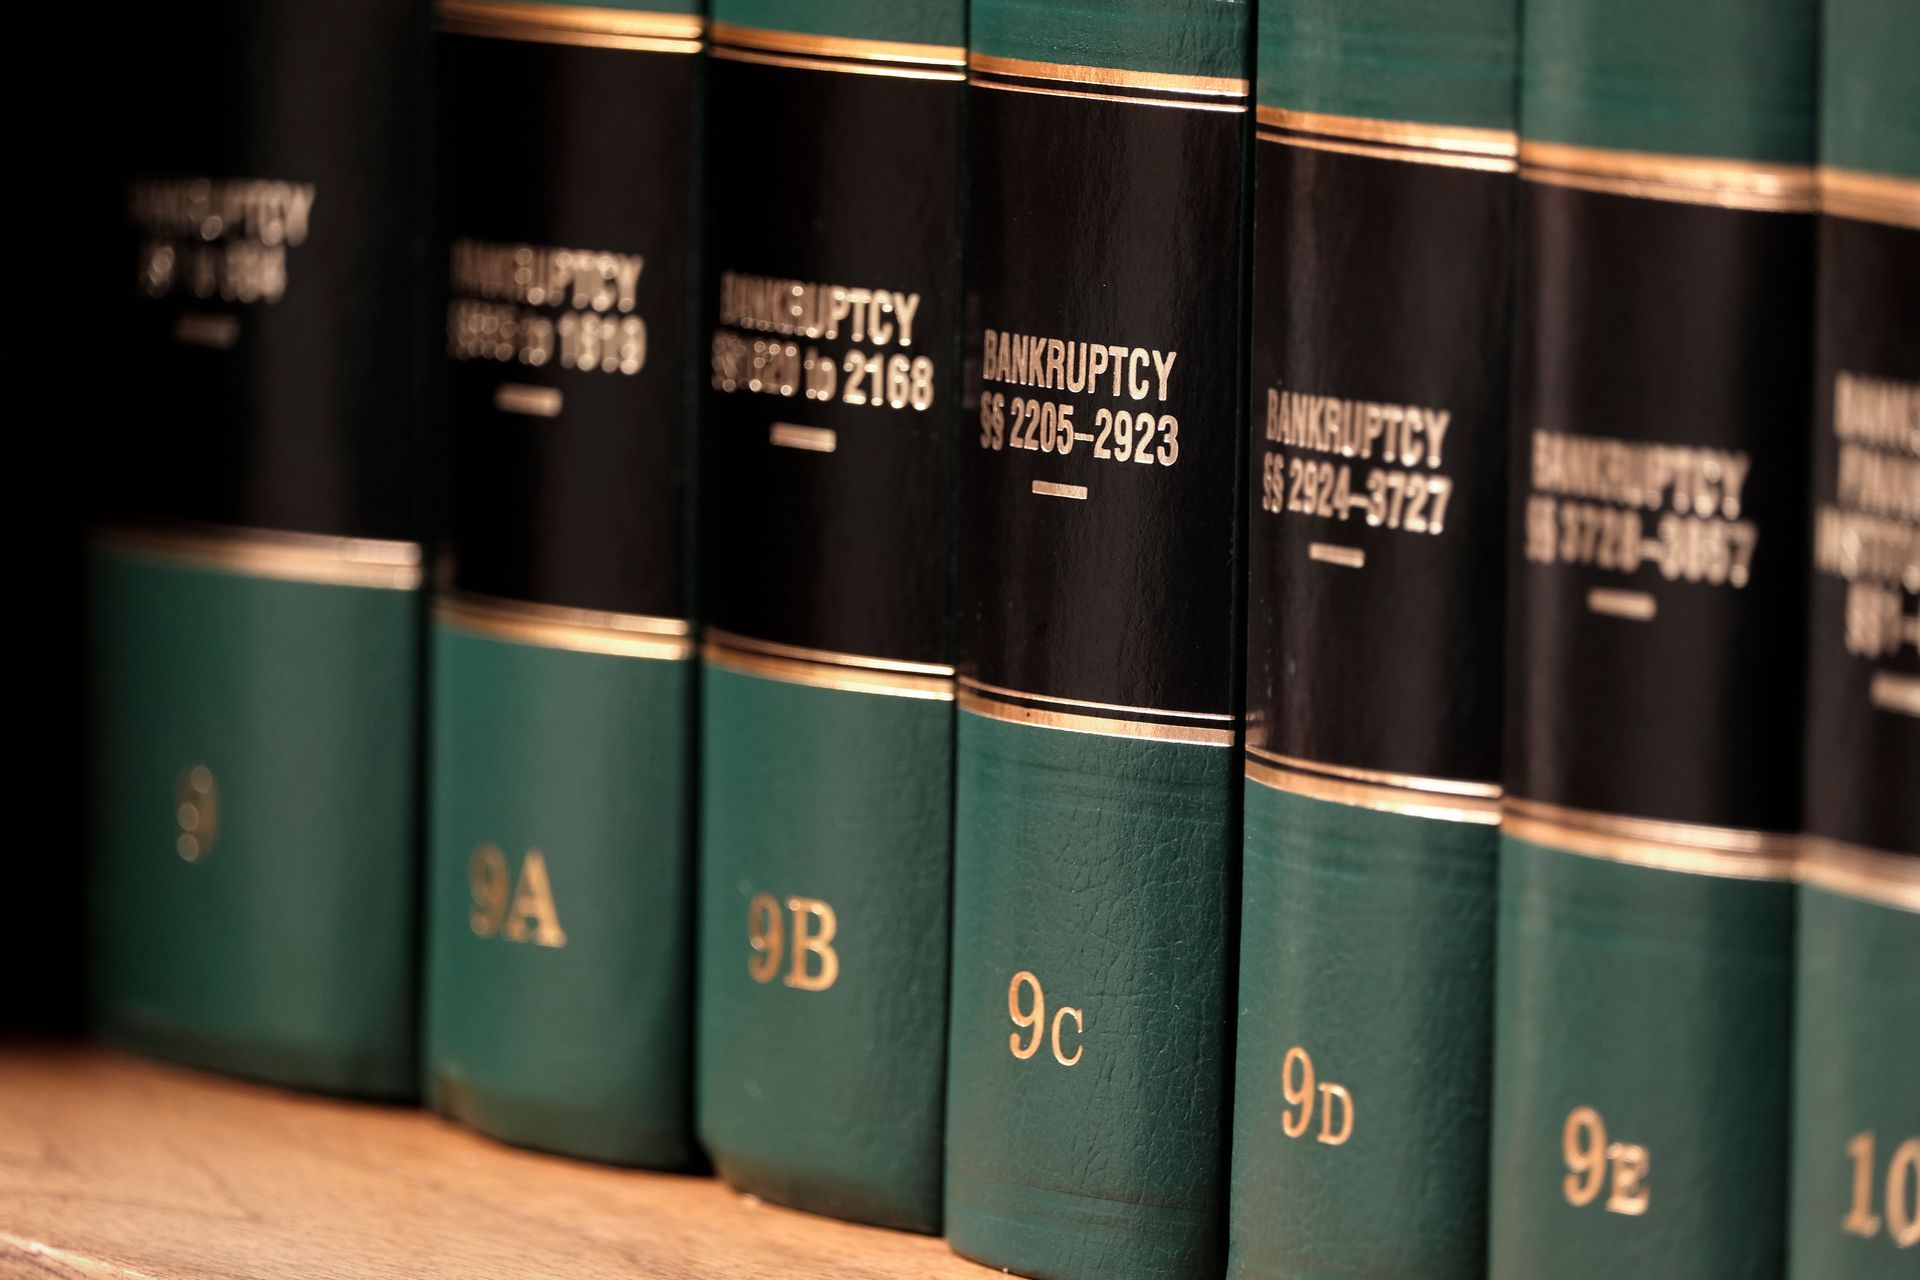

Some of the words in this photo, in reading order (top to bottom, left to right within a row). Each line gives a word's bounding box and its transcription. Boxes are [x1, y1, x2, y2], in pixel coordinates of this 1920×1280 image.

[452, 241, 643, 311] RUPTCY
[842, 349, 935, 411] 2168
[983, 329, 1177, 401] BANKRUPTCY
[980, 391, 1004, 451] §§
[1266, 388, 1450, 468] BANKRUPTCY
[469, 842, 567, 949] 9A
[747, 893, 840, 992] 9B
[1007, 970, 1085, 1067] 9C
[1281, 1046, 1354, 1146] 9D
[1563, 1105, 1651, 1217] 9E
[1842, 1130, 1920, 1248] 10
